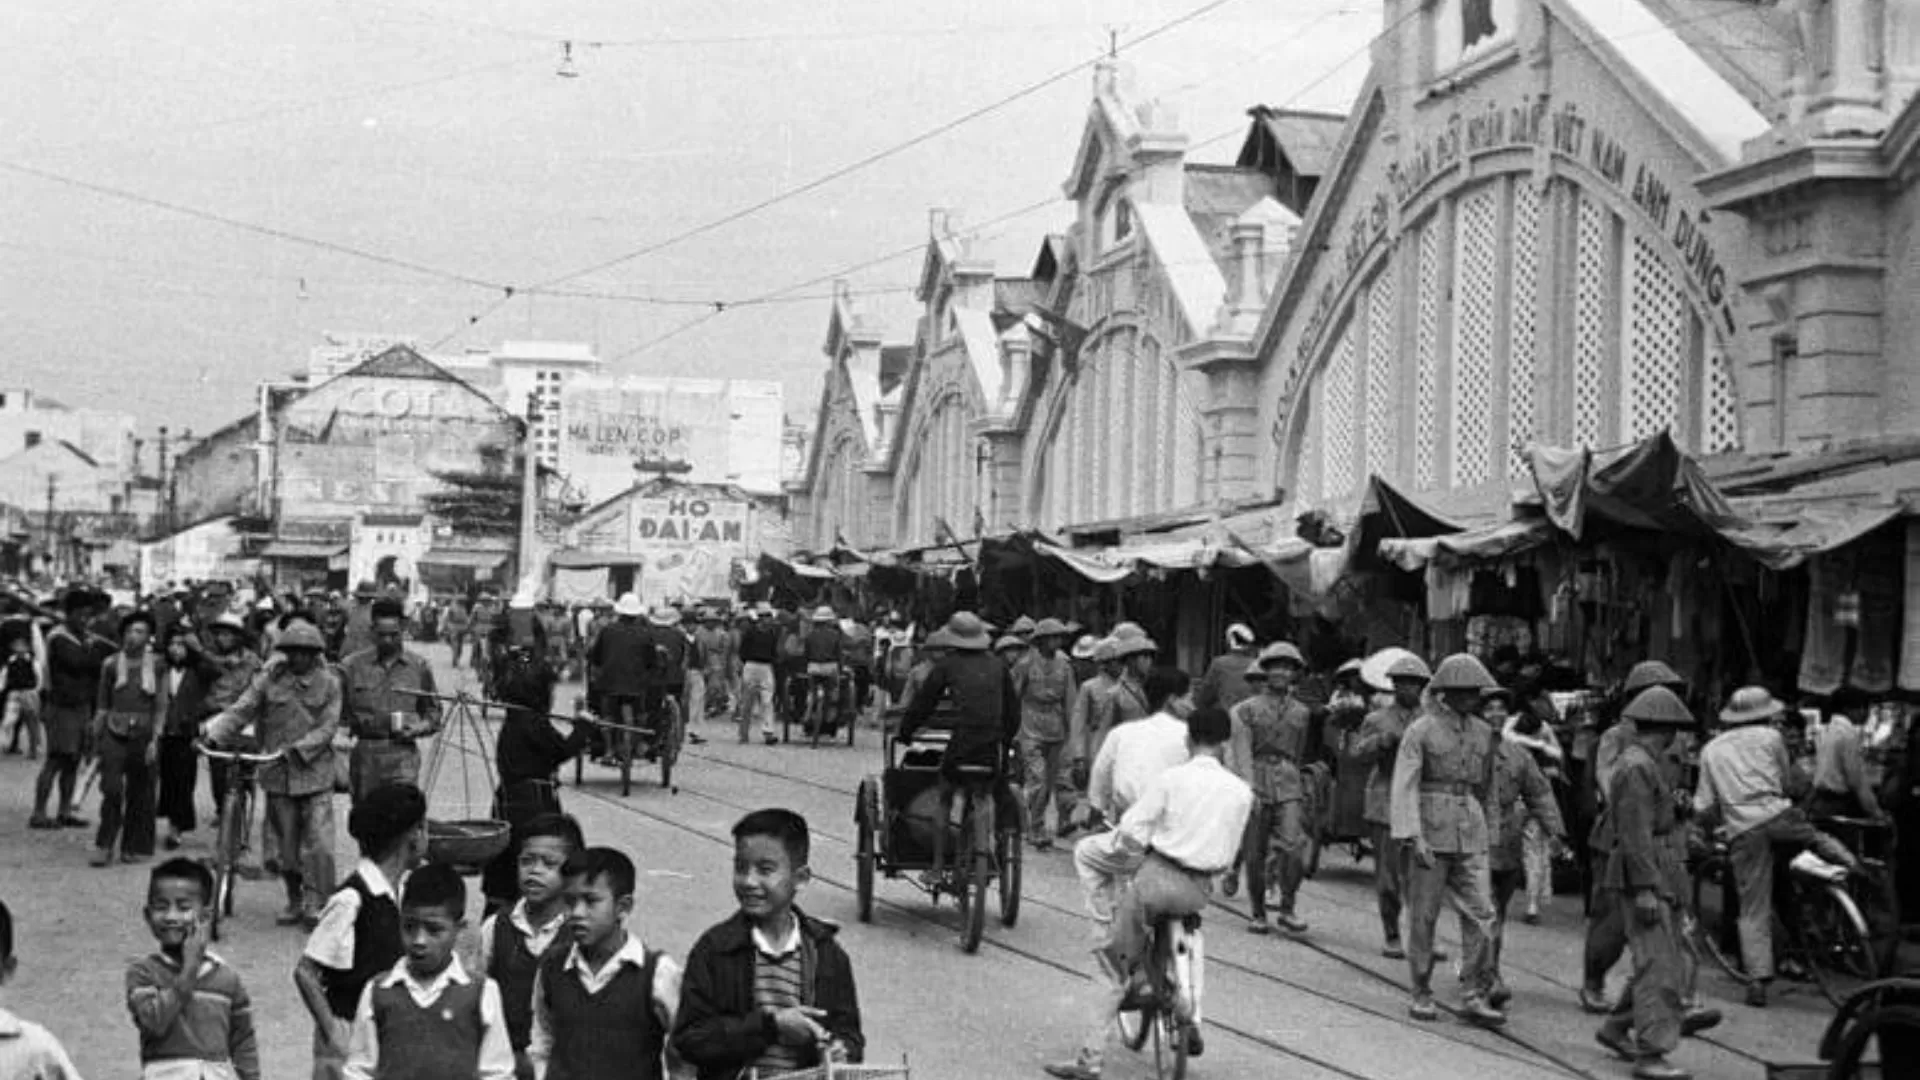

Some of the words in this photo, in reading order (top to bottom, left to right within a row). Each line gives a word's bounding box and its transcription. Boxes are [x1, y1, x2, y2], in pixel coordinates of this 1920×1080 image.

[1553, 101, 1585, 158] VIỆT
[1592, 127, 1627, 187] NAM
[1632, 161, 1672, 230] ANH
